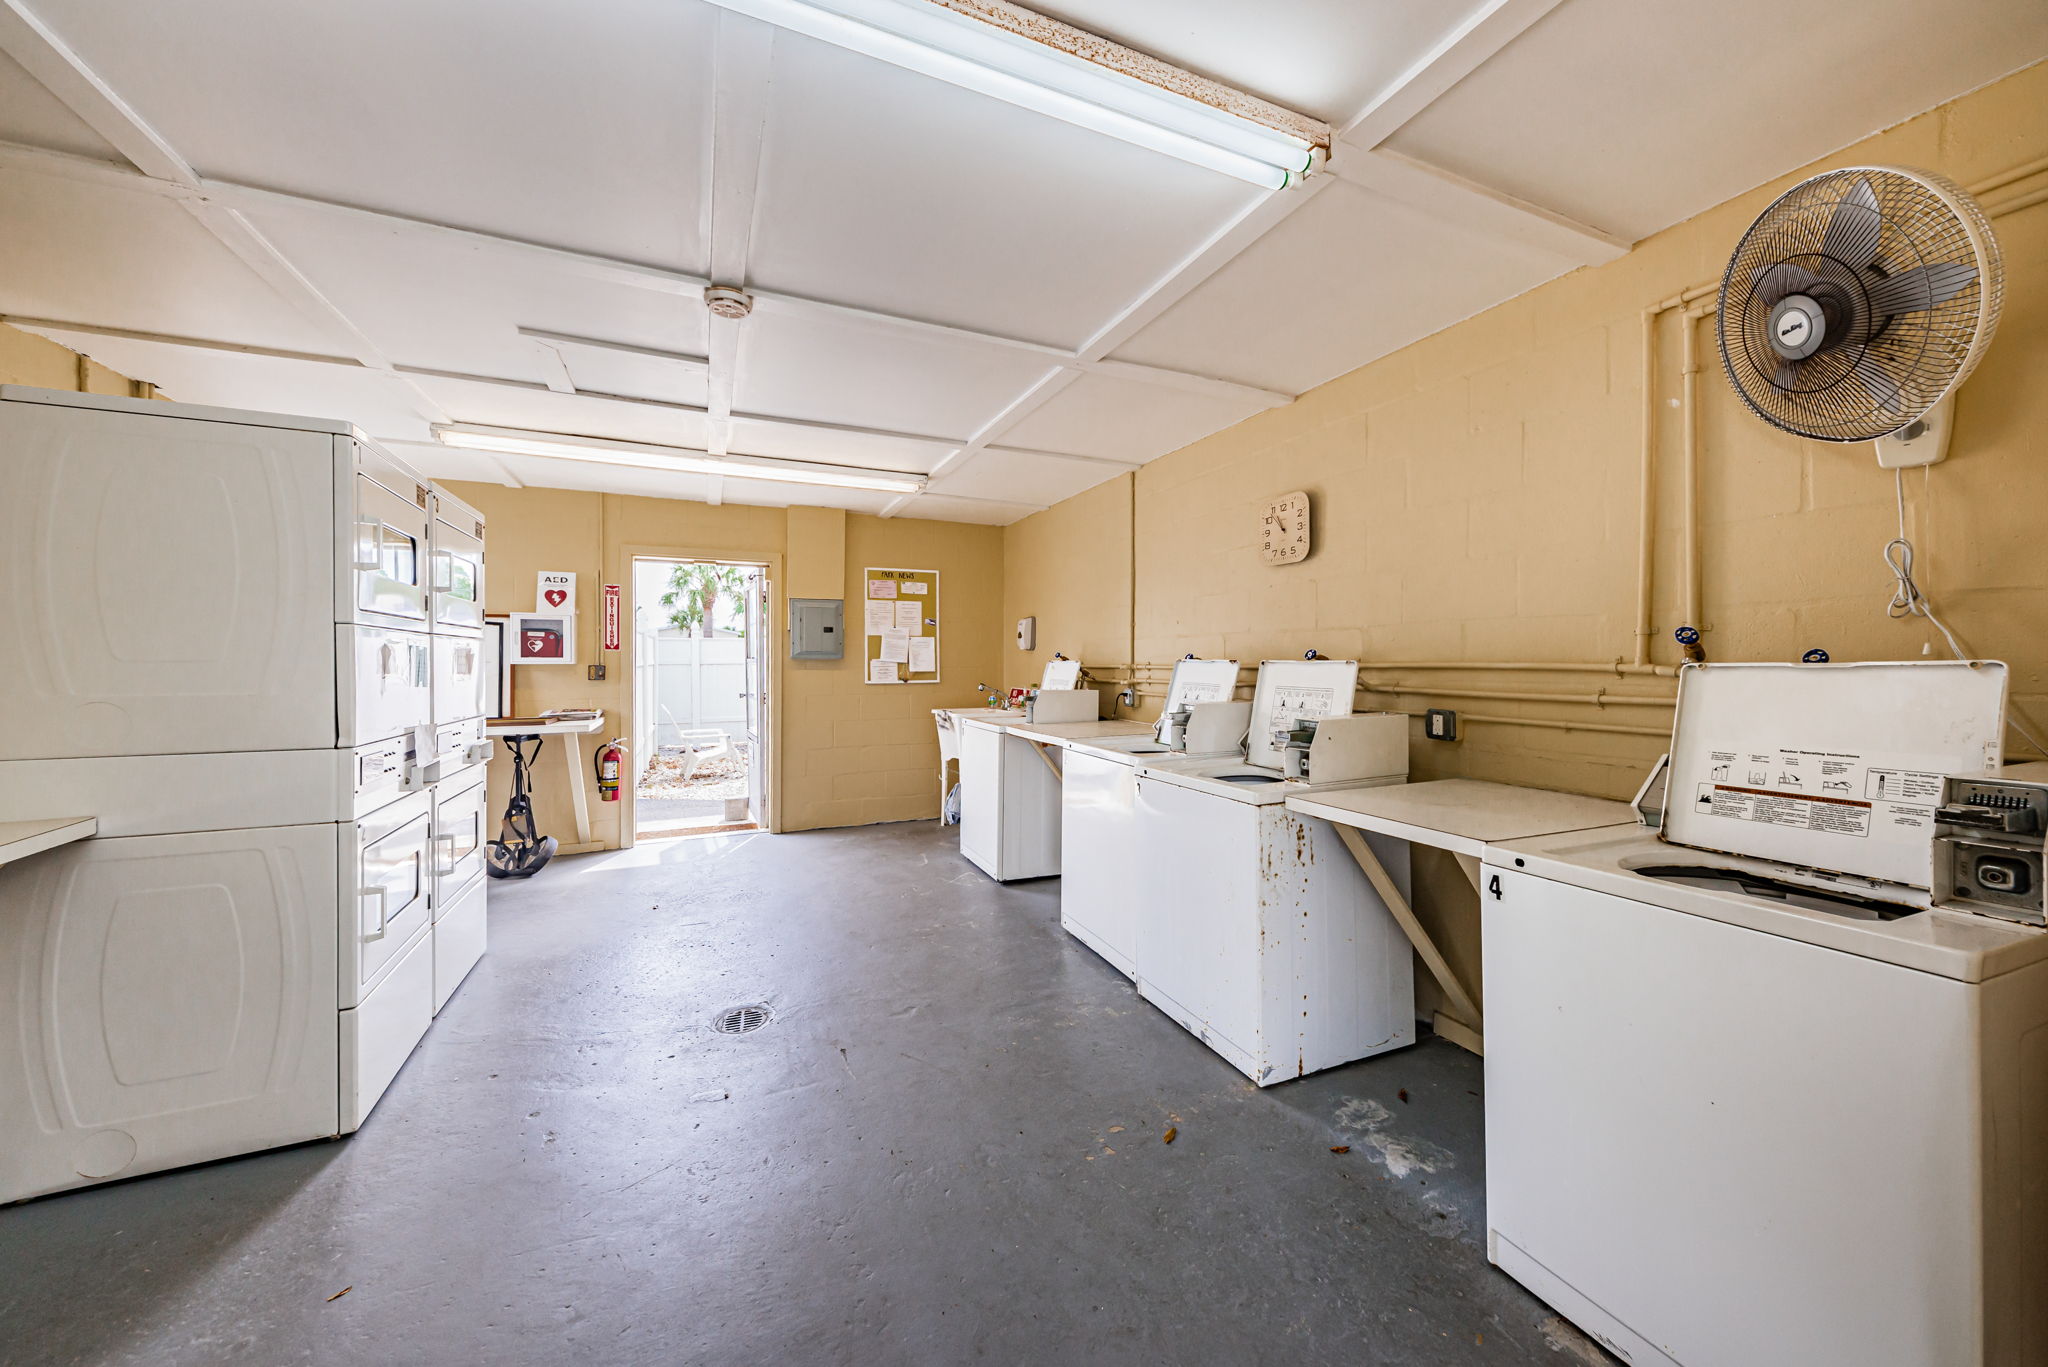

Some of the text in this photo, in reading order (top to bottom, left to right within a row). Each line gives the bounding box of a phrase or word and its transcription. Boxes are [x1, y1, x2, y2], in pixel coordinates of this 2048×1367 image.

[1280, 503, 1287, 512] 12
[1297, 508, 1303, 518] 2
[1265, 516, 1273, 525] 10
[1297, 522, 1303, 531] 3
[1264, 529, 1271, 538] 9
[1296, 535, 1303, 543] 4
[1264, 541, 1271, 550] 8
[1271, 549, 1278, 558] 7
[1280, 548, 1287, 557] 6
[1290, 546, 1297, 555] 5
[1489, 874, 1503, 901] 4
